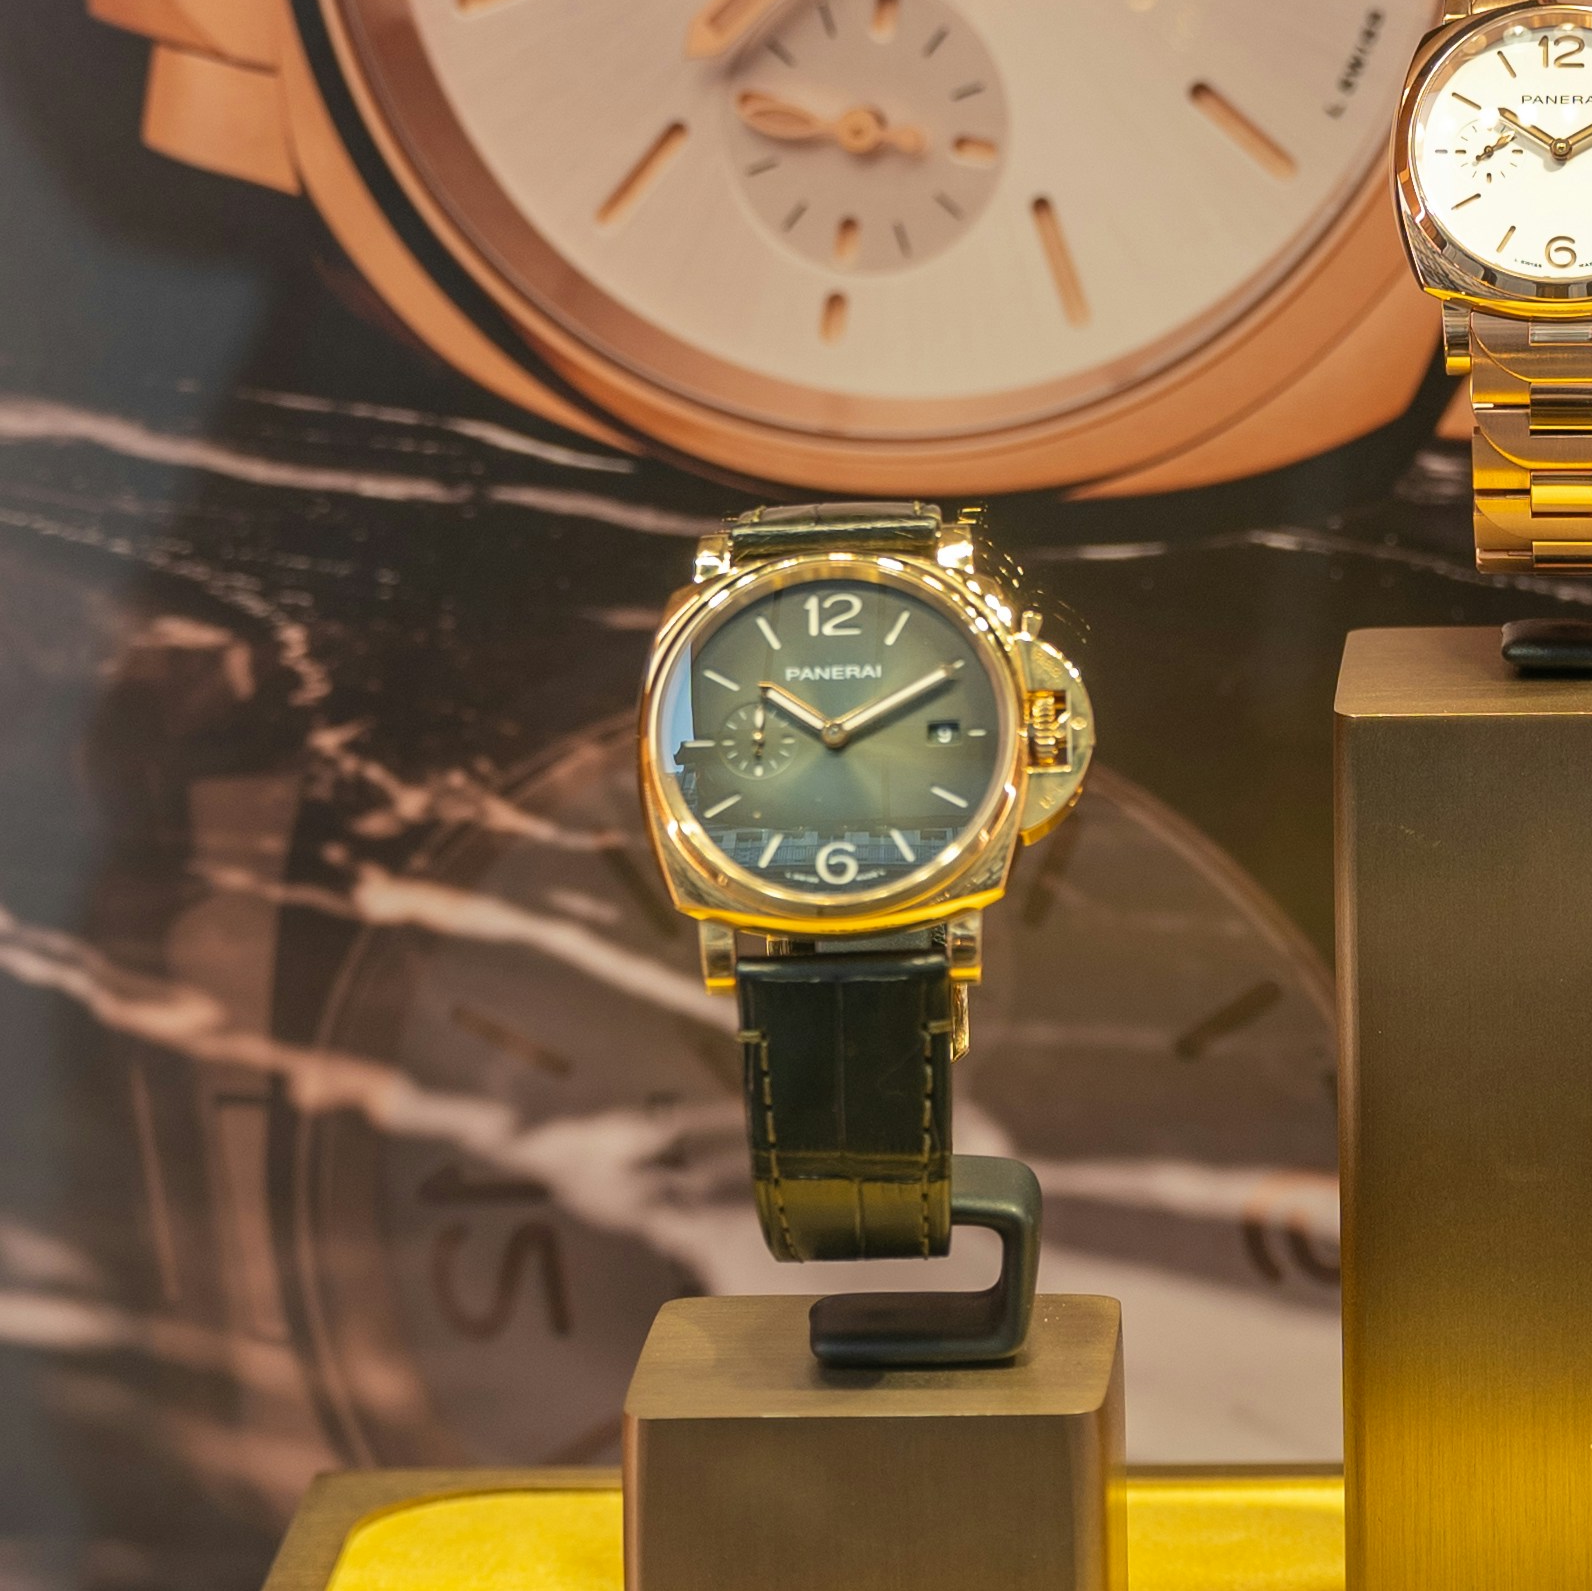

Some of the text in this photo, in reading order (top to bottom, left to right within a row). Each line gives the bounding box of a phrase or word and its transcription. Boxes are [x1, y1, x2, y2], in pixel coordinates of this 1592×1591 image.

[1537, 34, 1585, 68] 12
[1545, 236, 1577, 268] 6
[803, 594, 864, 637] 12
[784, 664, 883, 682] PANERAI
[815, 842, 859, 885] 6
